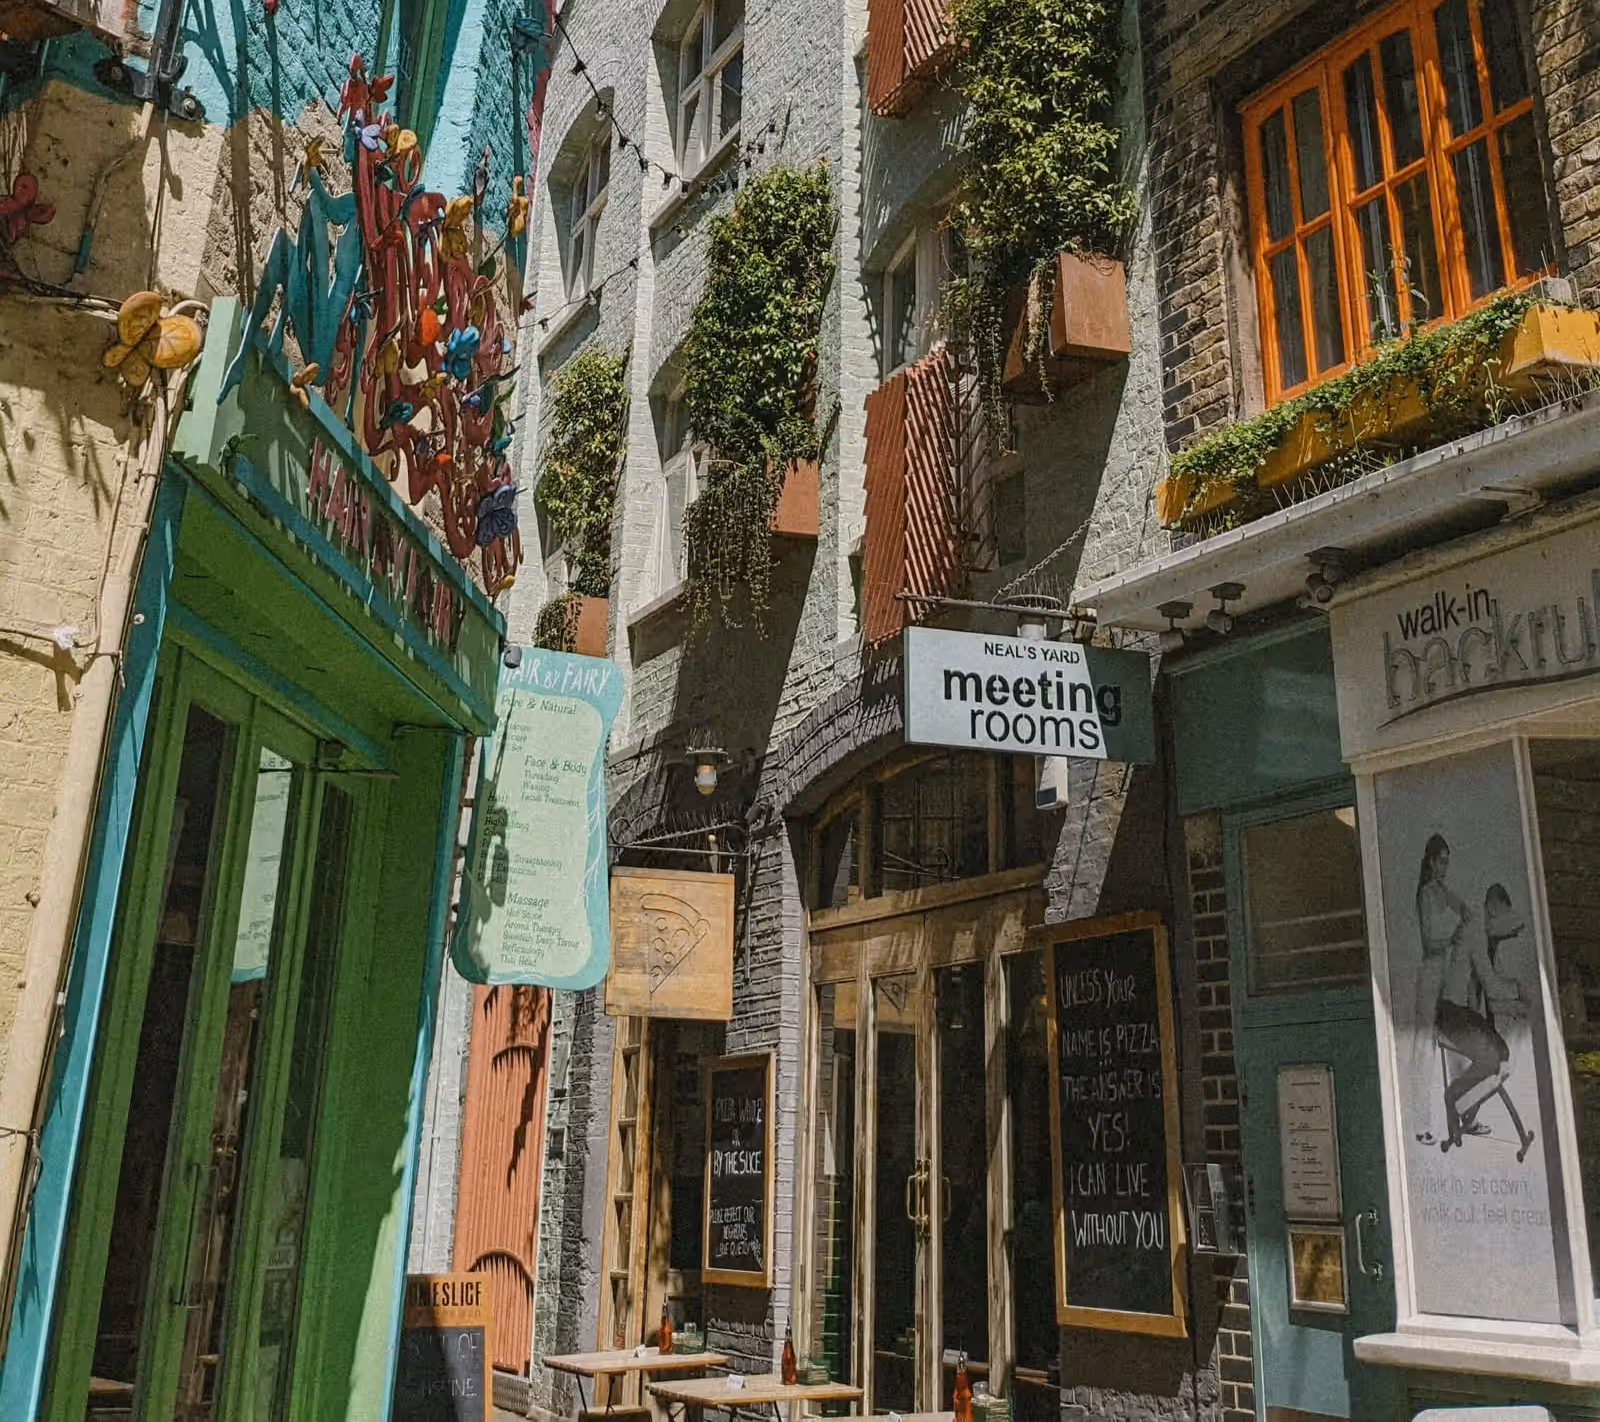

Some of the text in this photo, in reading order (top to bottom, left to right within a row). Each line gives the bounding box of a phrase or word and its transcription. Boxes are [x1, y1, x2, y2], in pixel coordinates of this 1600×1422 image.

[1397, 583, 1490, 641] walk-in
[984, 641, 1080, 664] NEAL'S YARD
[560, 662, 612, 696] FAIRY
[540, 699, 577, 715] Natural
[943, 669, 1122, 727] meeting
[970, 708, 1100, 750] rooms
[524, 755, 547, 768] Face
[563, 760, 587, 776] Body
[507, 891, 550, 911] Massage
[1060, 967, 1136, 1009] UNLESS YOUR
[1062, 1022, 1160, 1058] NAME IS PIZZA
[1061, 1074, 1089, 1102] THE
[713, 1149, 762, 1177] BY THE SLICE
[1078, 1162, 1107, 1196] CAN
[1116, 1162, 1150, 1197] LIVE
[1071, 1209, 1165, 1250] WITHOUT YOU
